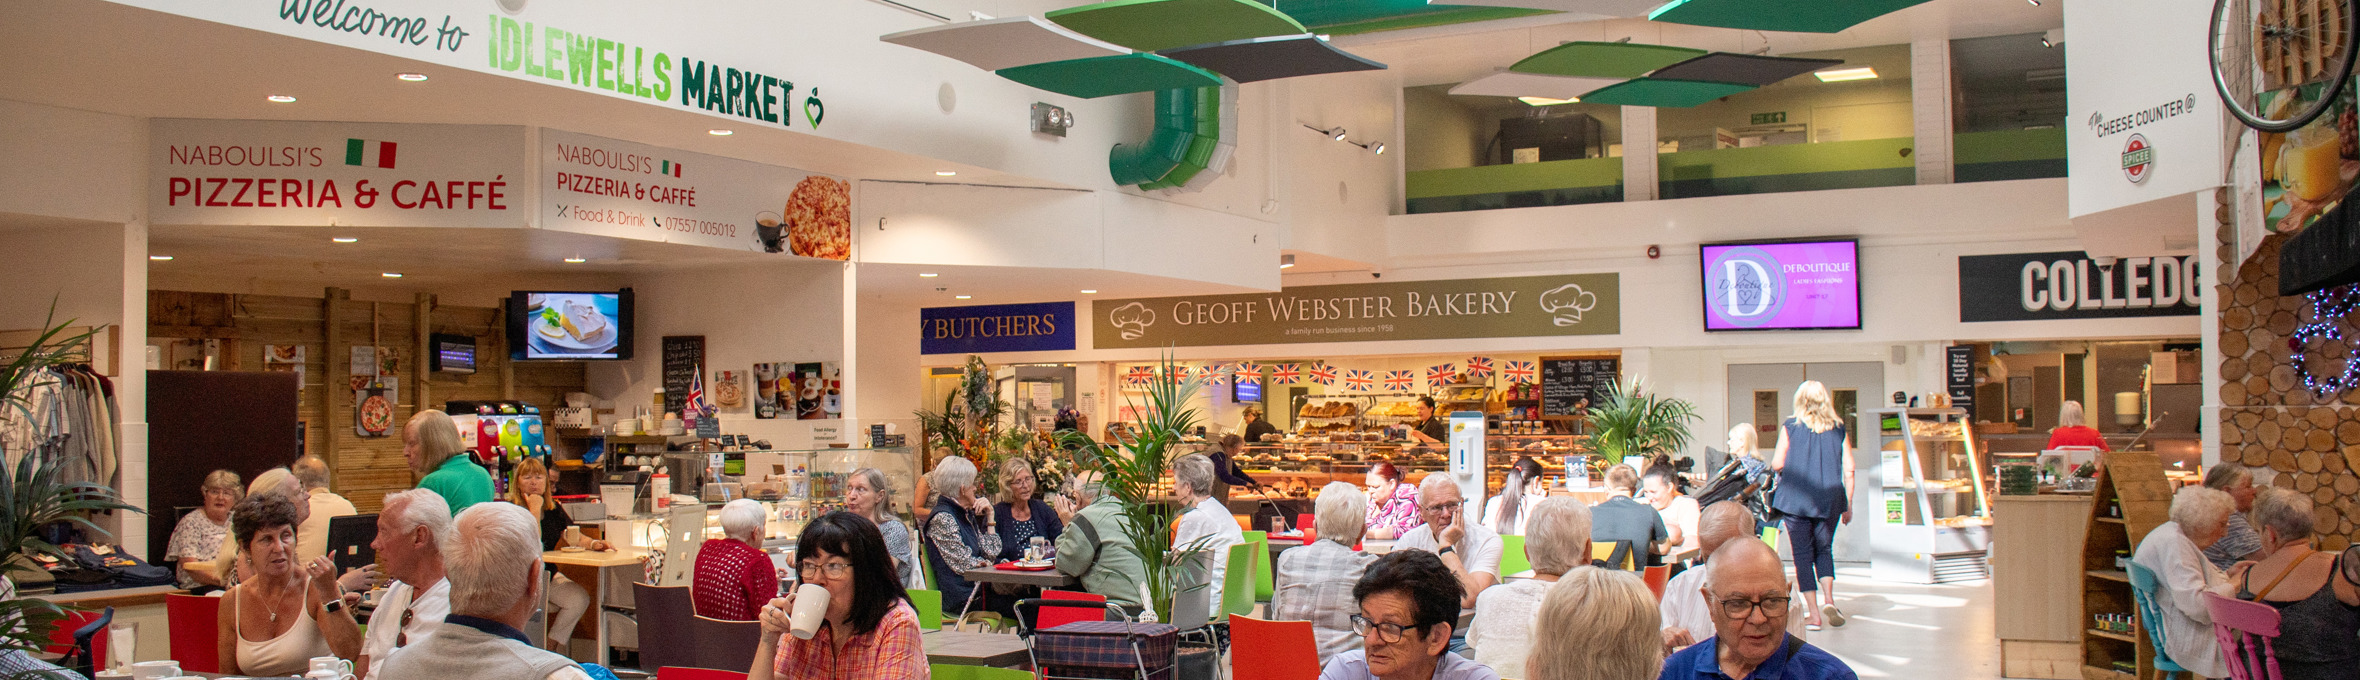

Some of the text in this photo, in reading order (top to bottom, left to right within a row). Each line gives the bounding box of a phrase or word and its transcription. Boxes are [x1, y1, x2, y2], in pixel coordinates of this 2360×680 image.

[280, 0, 470, 52] Welcome to
[488, 14, 794, 126] IDLEWELLS MARKET
[2097, 93, 2196, 138] CHEESE COUNTER @
[169, 145, 323, 167] NABOULSI'S
[557, 143, 652, 174] NABOULSI'S
[2123, 150, 2150, 166] SPICEE
[168, 174, 507, 210] PIZZERIA & CAFFÉ
[557, 172, 696, 207] PIZZERIA & CAFFÉ
[573, 205, 646, 228] Food & Drink
[665, 217, 736, 238] 07557 005012
[1783, 262, 1851, 274] DEBOUTIQUE
[935, 313, 1056, 340] BUTCHERS
[1291, 327, 1311, 336] family
[1325, 326, 1356, 334] business
[1357, 325, 1376, 333] since
[1377, 324, 1394, 332] 1958
